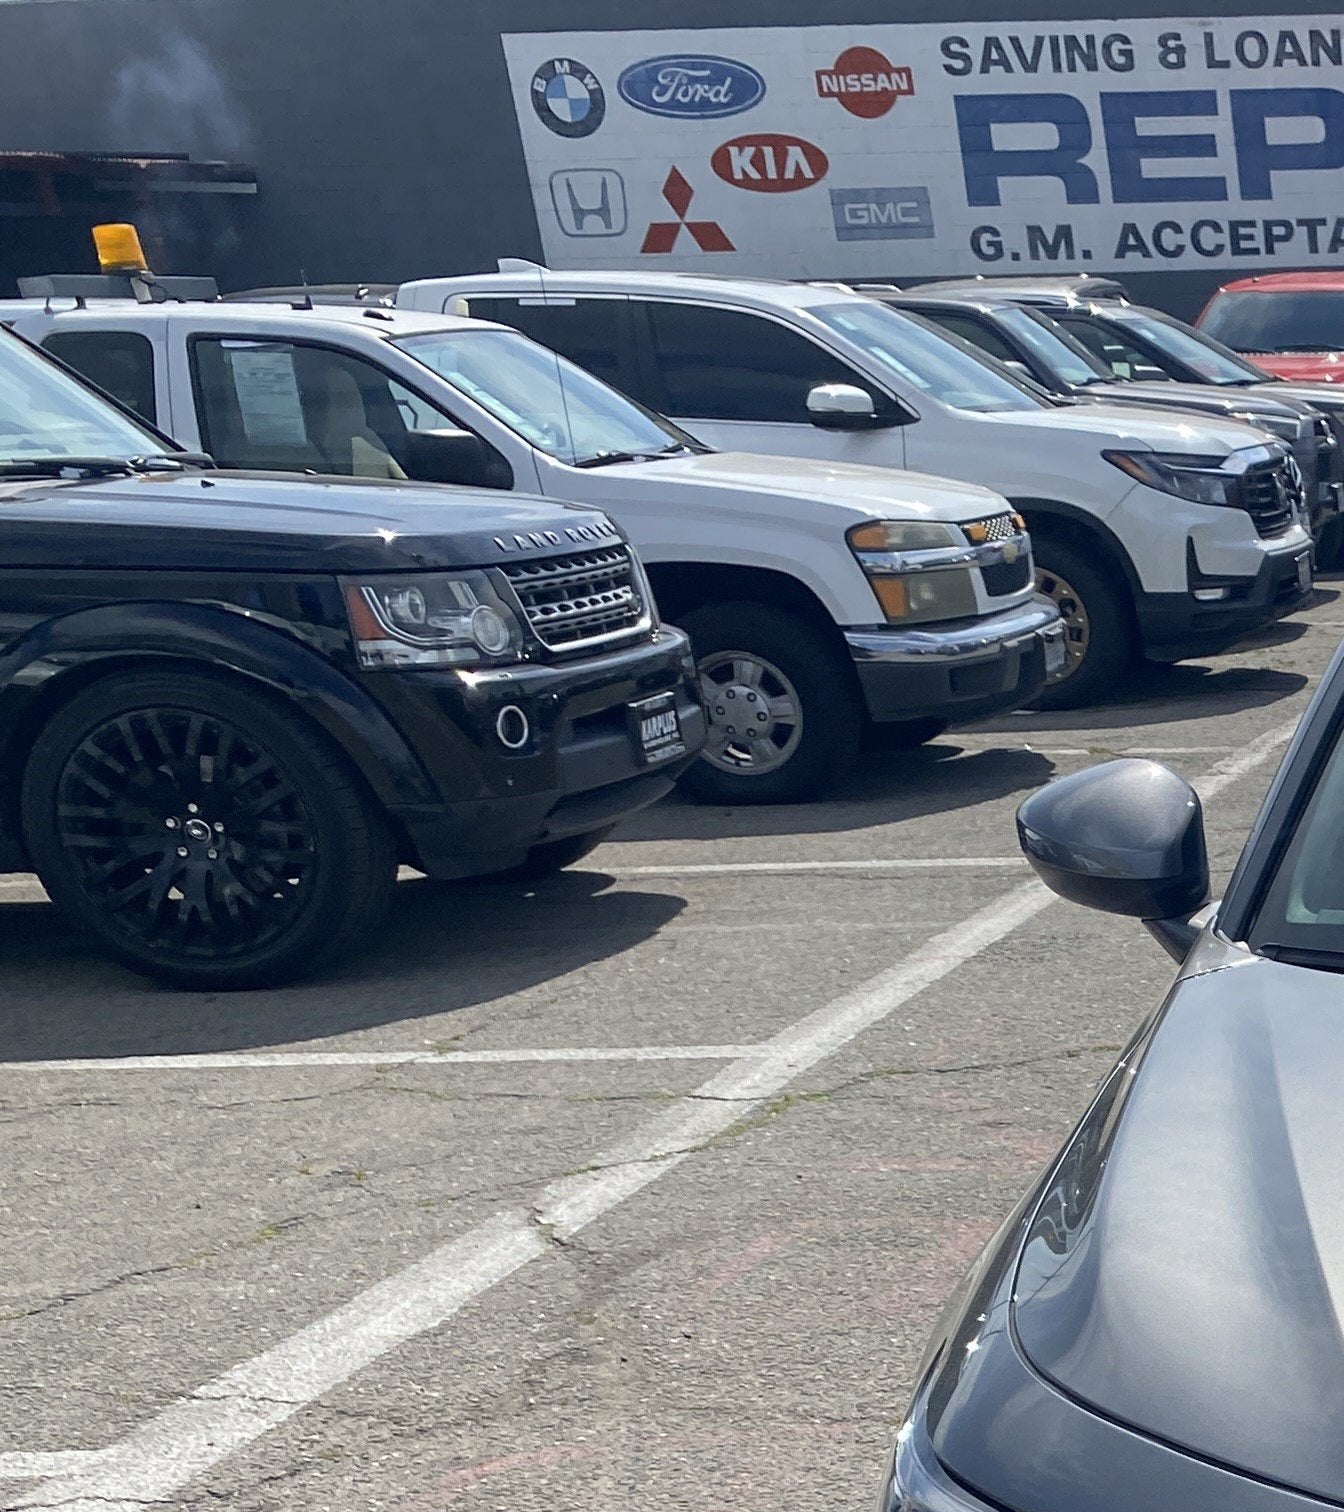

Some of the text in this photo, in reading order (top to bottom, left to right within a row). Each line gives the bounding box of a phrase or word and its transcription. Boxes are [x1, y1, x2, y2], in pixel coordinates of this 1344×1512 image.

[940, 33, 1135, 76] SAVING
[1158, 31, 1188, 70] &
[533, 60, 600, 93] BMW
[652, 67, 734, 104] Ford
[821, 71, 909, 94] NISSAN
[727, 146, 814, 180] KIA
[844, 201, 920, 226] GMC
[970, 223, 1093, 262] G.M.
[493, 530, 563, 554] LAND
